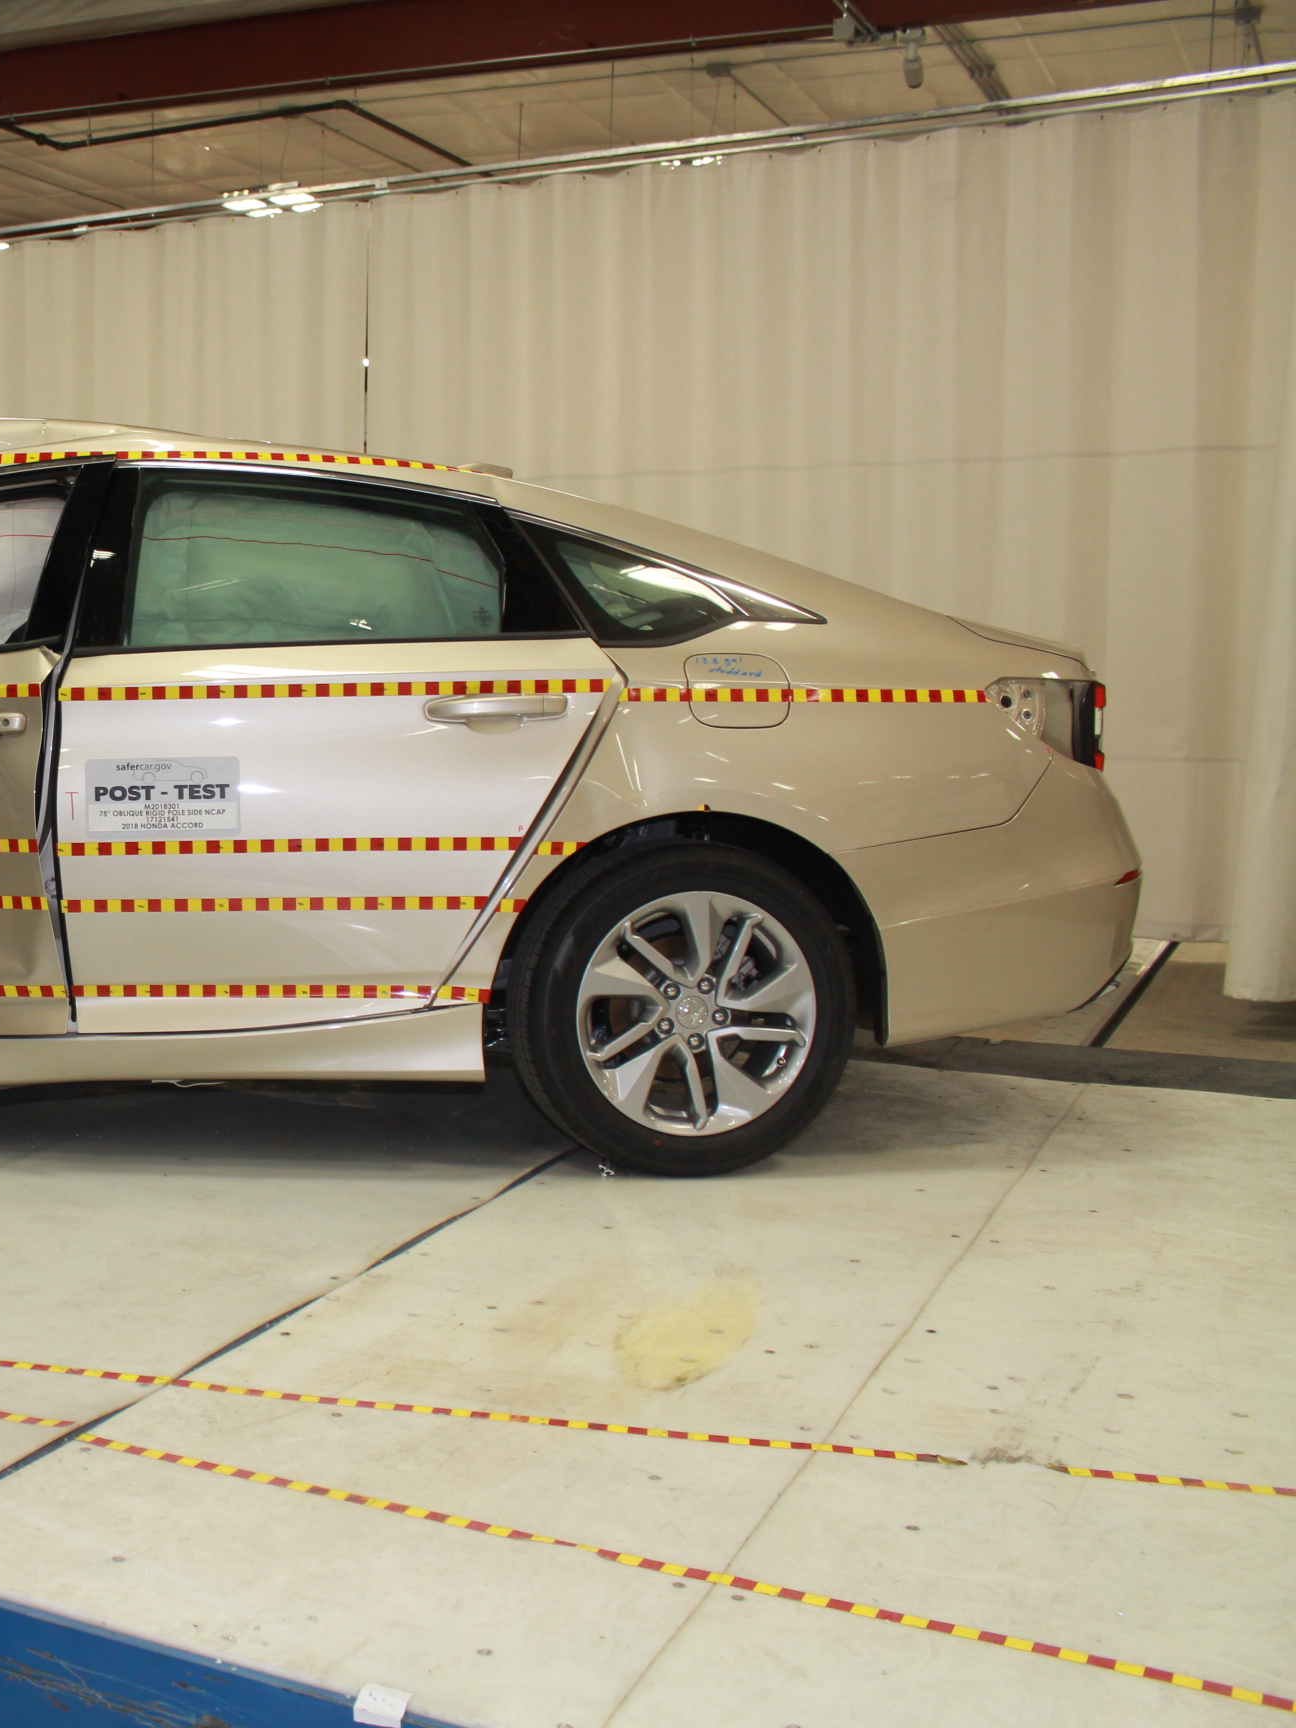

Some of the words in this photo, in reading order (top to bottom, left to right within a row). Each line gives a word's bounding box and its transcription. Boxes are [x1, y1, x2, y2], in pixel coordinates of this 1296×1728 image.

[724, 656, 742, 666] gal
[116, 762, 172, 773] safercar.gov
[94, 785, 155, 802] POST
[173, 783, 230, 800] TEST
[204, 808, 226, 816] NCAP
